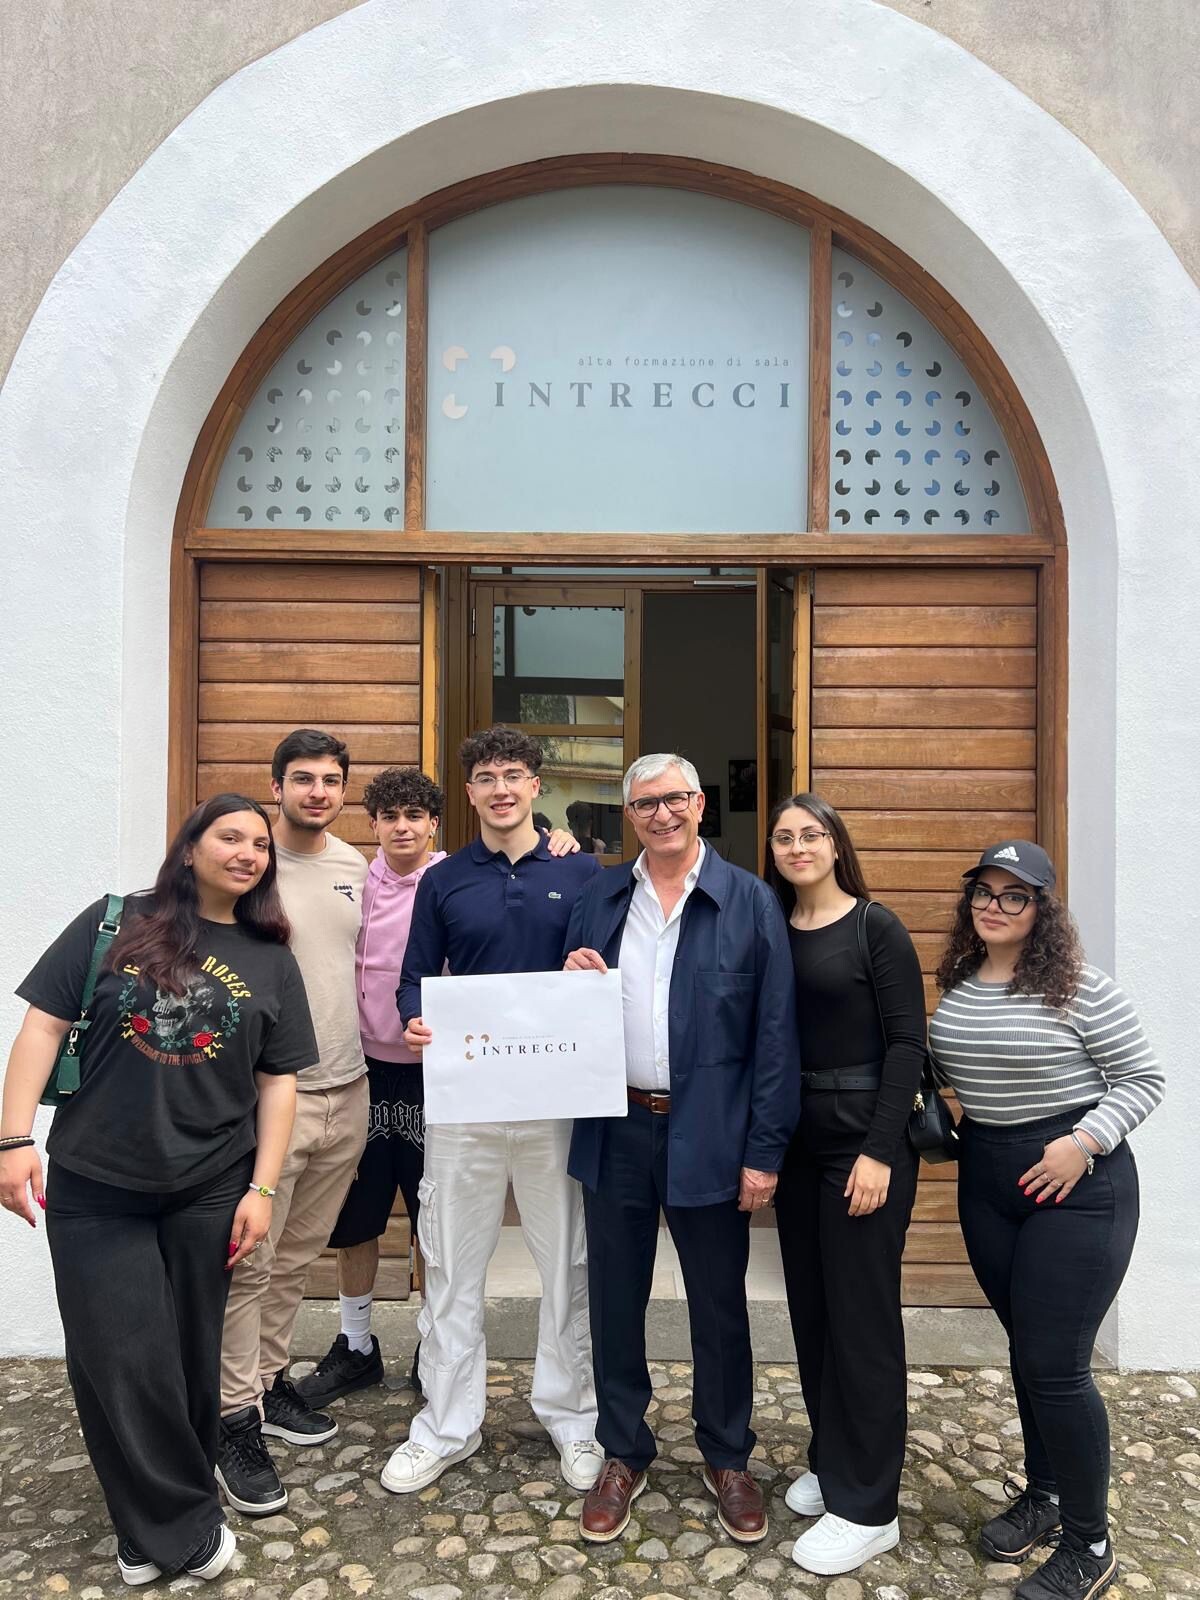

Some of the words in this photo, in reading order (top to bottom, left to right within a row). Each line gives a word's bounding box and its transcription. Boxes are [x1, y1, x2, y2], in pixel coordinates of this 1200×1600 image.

[578, 356, 613, 367] alta
[624, 356, 715, 367] formazione
[726, 356, 743, 367] di
[754, 356, 791, 367] sala
[494, 381, 791, 408] INTRECCI
[201, 955, 251, 998] ROSES
[482, 1042, 577, 1056] INTRECCI
[159, 1052, 168, 1065] TO
[168, 1054, 181, 1066] THE
